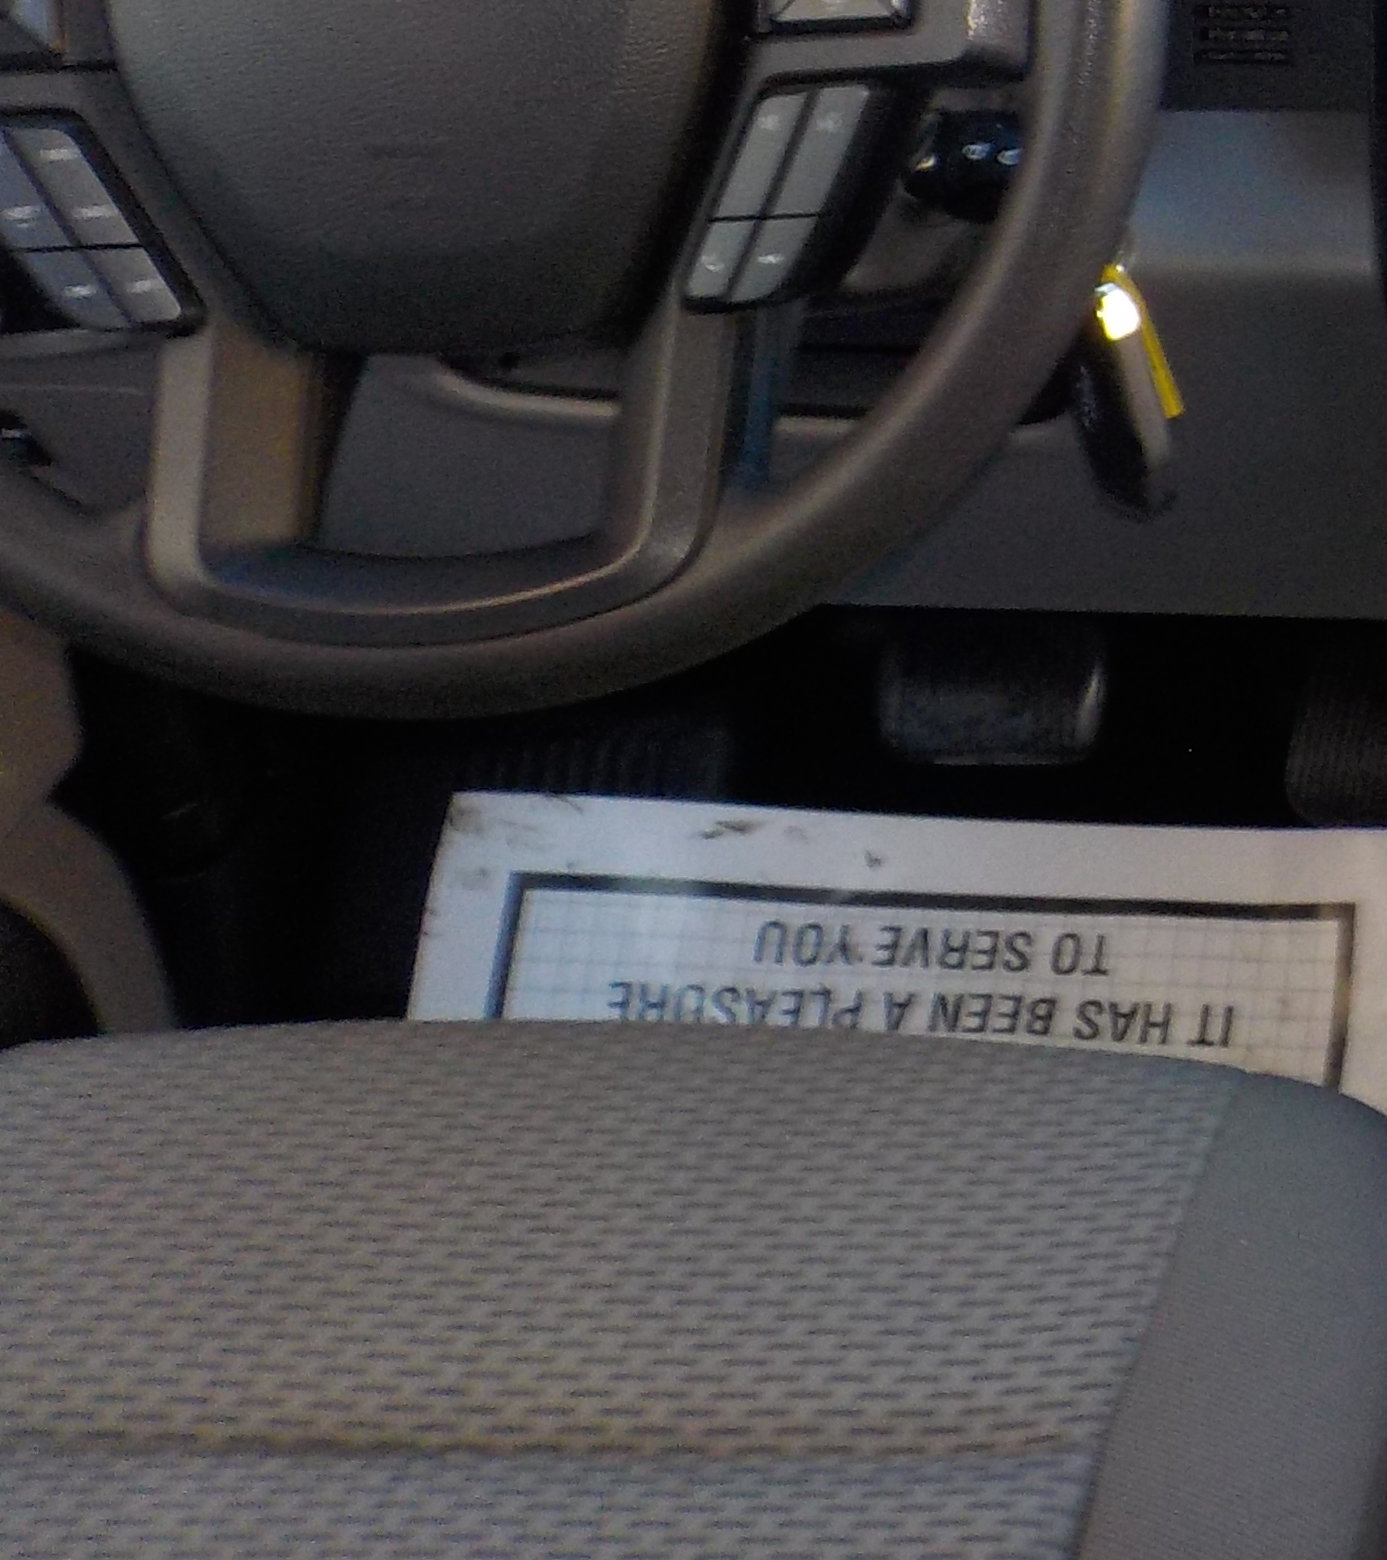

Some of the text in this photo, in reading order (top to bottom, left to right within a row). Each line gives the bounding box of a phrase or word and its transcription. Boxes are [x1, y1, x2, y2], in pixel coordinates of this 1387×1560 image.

[750, 919, 1110, 977] TO SERVE YOU
[881, 991, 915, 1034] A
[929, 992, 1058, 1036] BEEN
[1072, 997, 1174, 1048] HAS
[1185, 1003, 1236, 1049] IT
